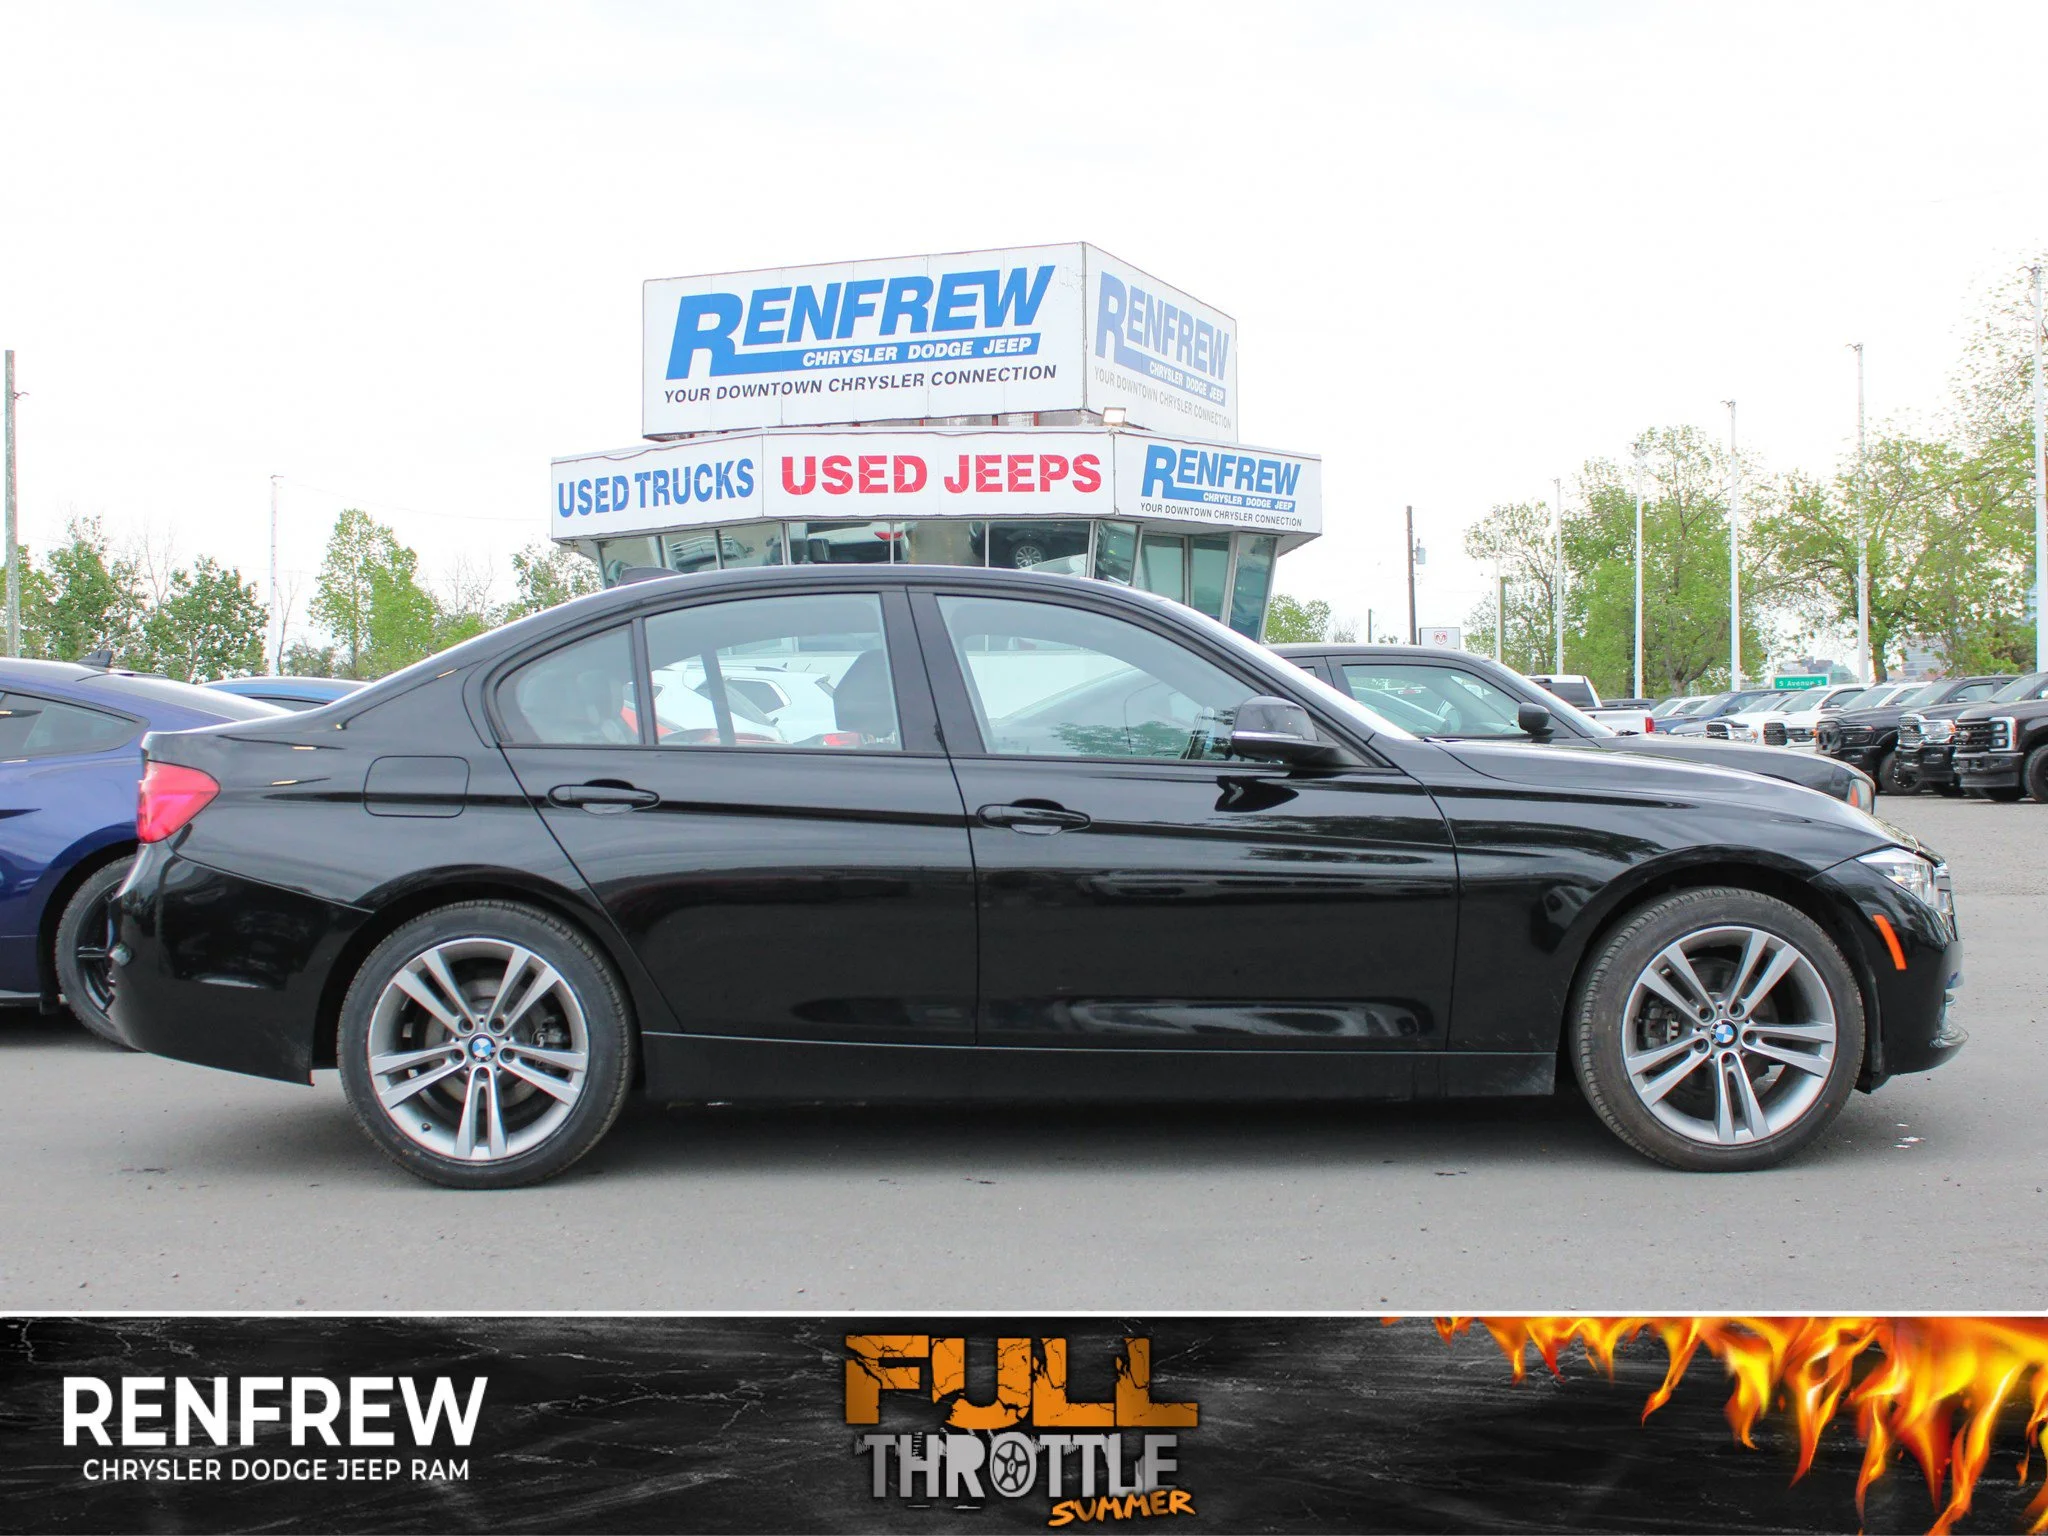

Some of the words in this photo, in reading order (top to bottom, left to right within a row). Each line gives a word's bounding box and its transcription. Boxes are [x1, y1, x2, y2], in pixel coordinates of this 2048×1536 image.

[665, 265, 1056, 380] RENFREW
[1095, 271, 1229, 380] RENFREW
[803, 346, 897, 367] CHRYSLER
[907, 342, 973, 359] DODGE
[983, 338, 1032, 355] JEEP
[664, 387, 711, 404] YOUR
[716, 379, 823, 401] DOWNTOWN
[828, 372, 924, 393] CHRYSLER
[931, 365, 1057, 387] CONNECTION
[1095, 367, 1115, 387] YOUR
[1116, 375, 1158, 403] DOWNTOWN
[1160, 391, 1192, 413] CHRYSLER
[1194, 405, 1232, 429] CONNECTION
[1150, 361, 1183, 384] CHRYSLER
[1186, 377, 1207, 396] DODGE
[1210, 386, 1223, 402] JEEP
[559, 475, 629, 518] USED
[635, 458, 754, 508] TRUCKS
[782, 455, 927, 495] USED
[944, 454, 1102, 493] JEEPS
[1141, 444, 1301, 498] RENFREW
[1141, 502, 1163, 513] YOUR
[1165, 505, 1211, 517] DOWNTOWN
[1214, 510, 1252, 521] CHRYSLER
[1255, 514, 1302, 526] CONNECTION
[1204, 492, 1242, 505] CHRYSLER
[1246, 497, 1271, 508] DODGE
[1275, 501, 1292, 510] JEEP
